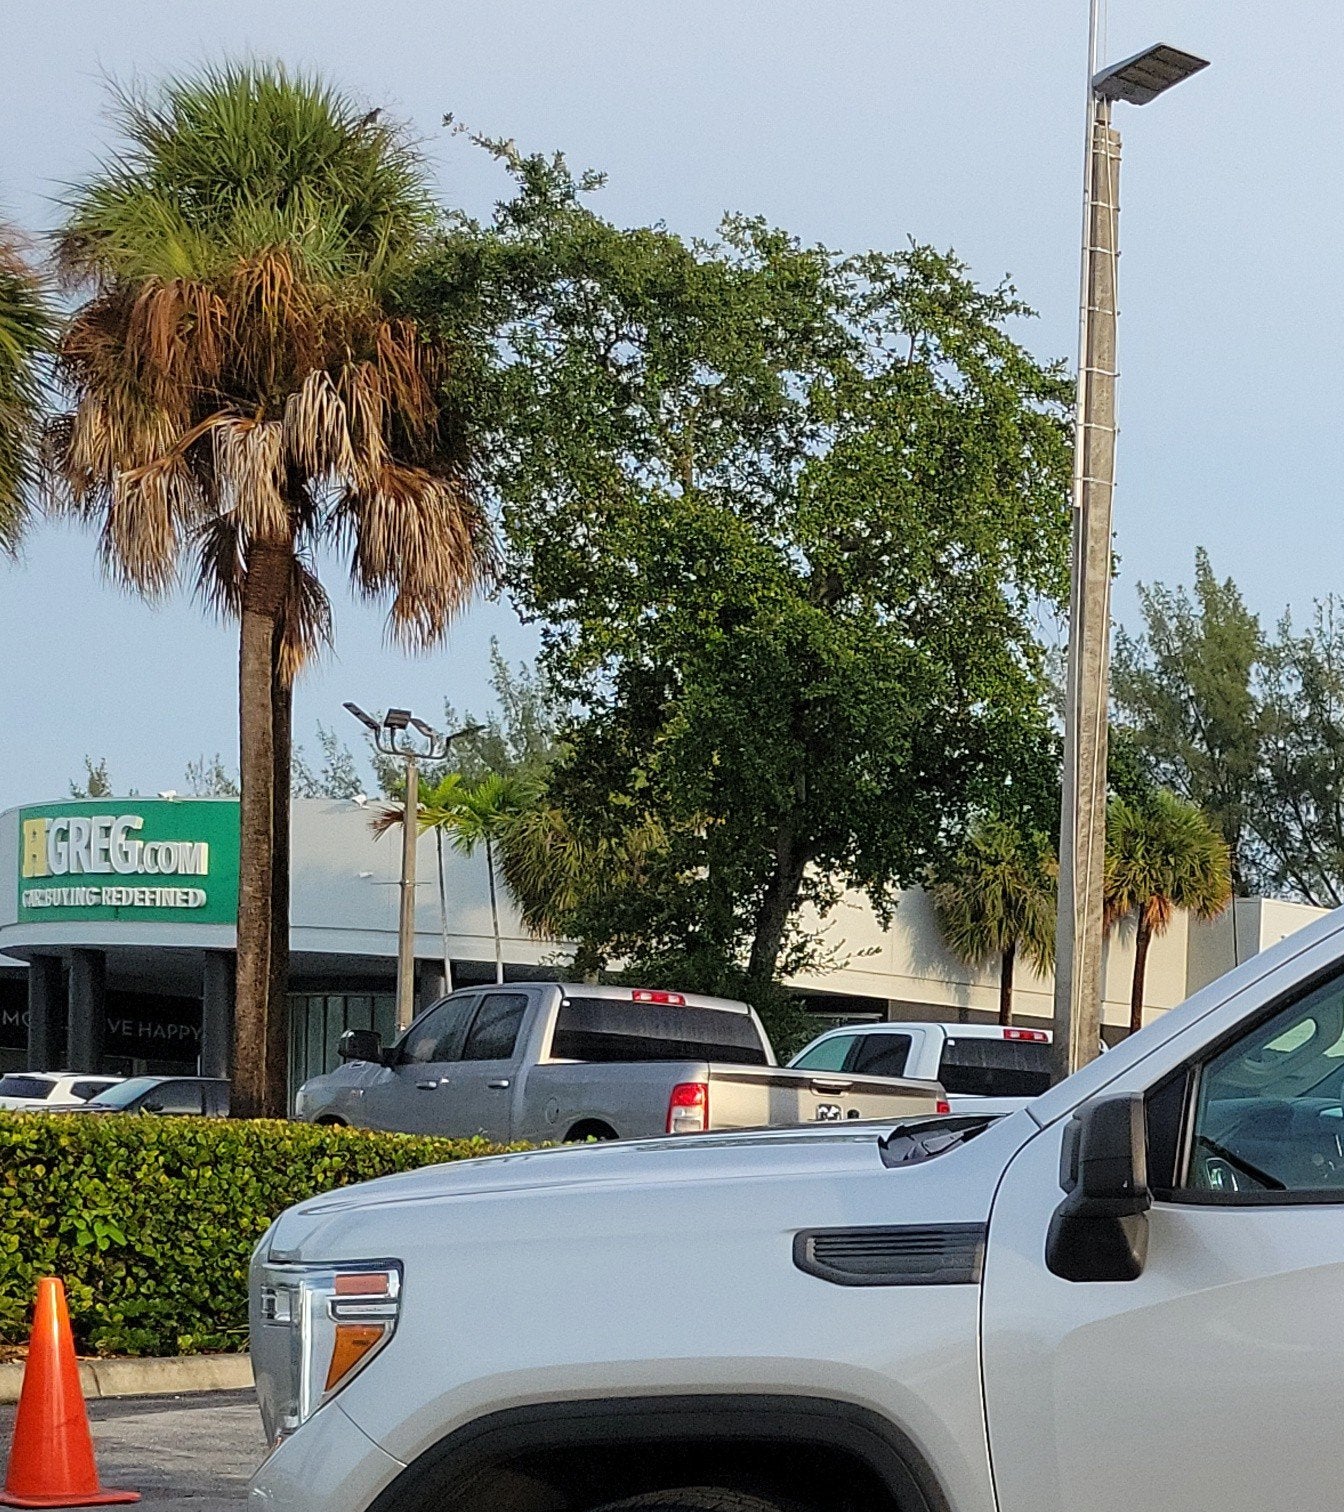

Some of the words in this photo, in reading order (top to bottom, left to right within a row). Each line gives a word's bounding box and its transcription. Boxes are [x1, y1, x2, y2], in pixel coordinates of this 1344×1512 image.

[46, 887, 102, 907] BUYING
[101, 887, 206, 907] REDEFINED
[138, 1020, 203, 1041] HAPPY
